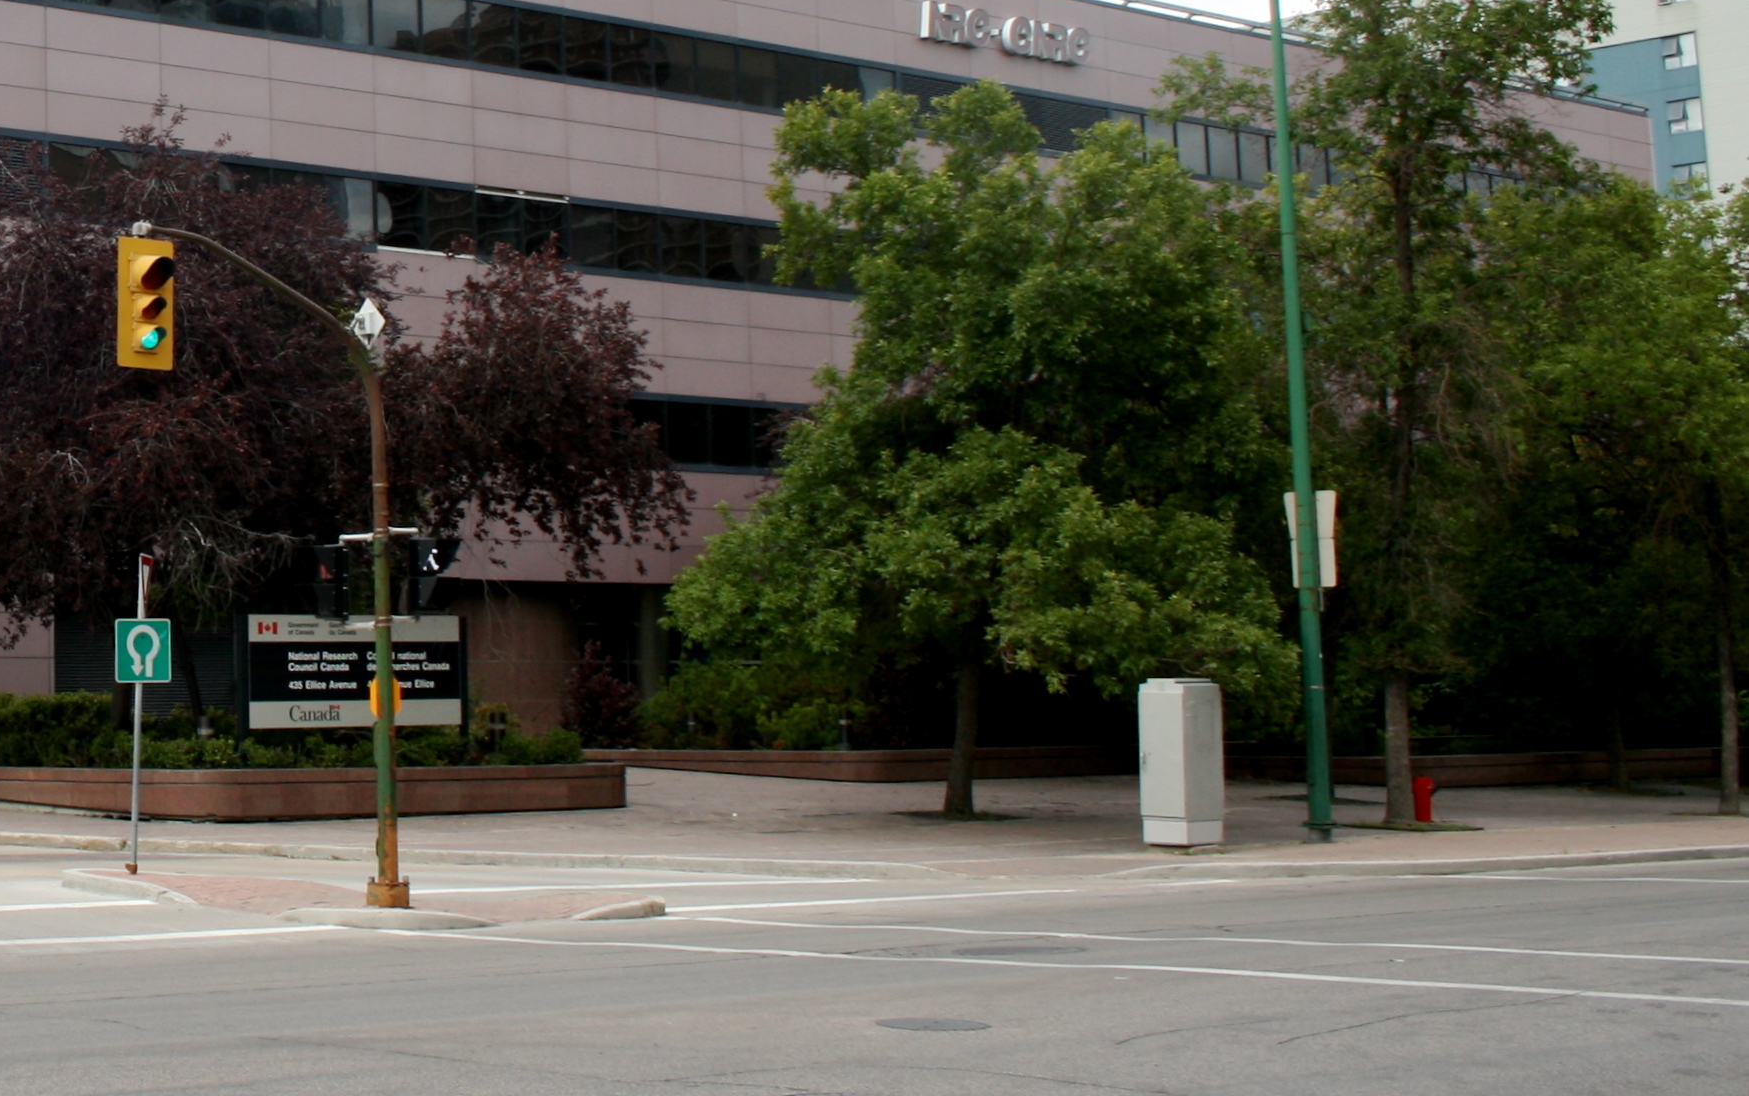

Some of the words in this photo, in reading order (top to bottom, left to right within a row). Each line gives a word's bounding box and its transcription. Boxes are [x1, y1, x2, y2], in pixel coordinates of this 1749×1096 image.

[288, 651, 320, 661] National
[322, 651, 359, 661] Research
[397, 652, 427, 660] national
[288, 662, 318, 672] Council
[320, 662, 349, 672] Canada
[422, 661, 450, 671] Canada
[288, 680, 303, 690] 435
[305, 680, 327, 690] Ellice
[329, 680, 357, 690] Avenue
[414, 679, 435, 689] Ellice
[289, 705, 341, 722] Canada
